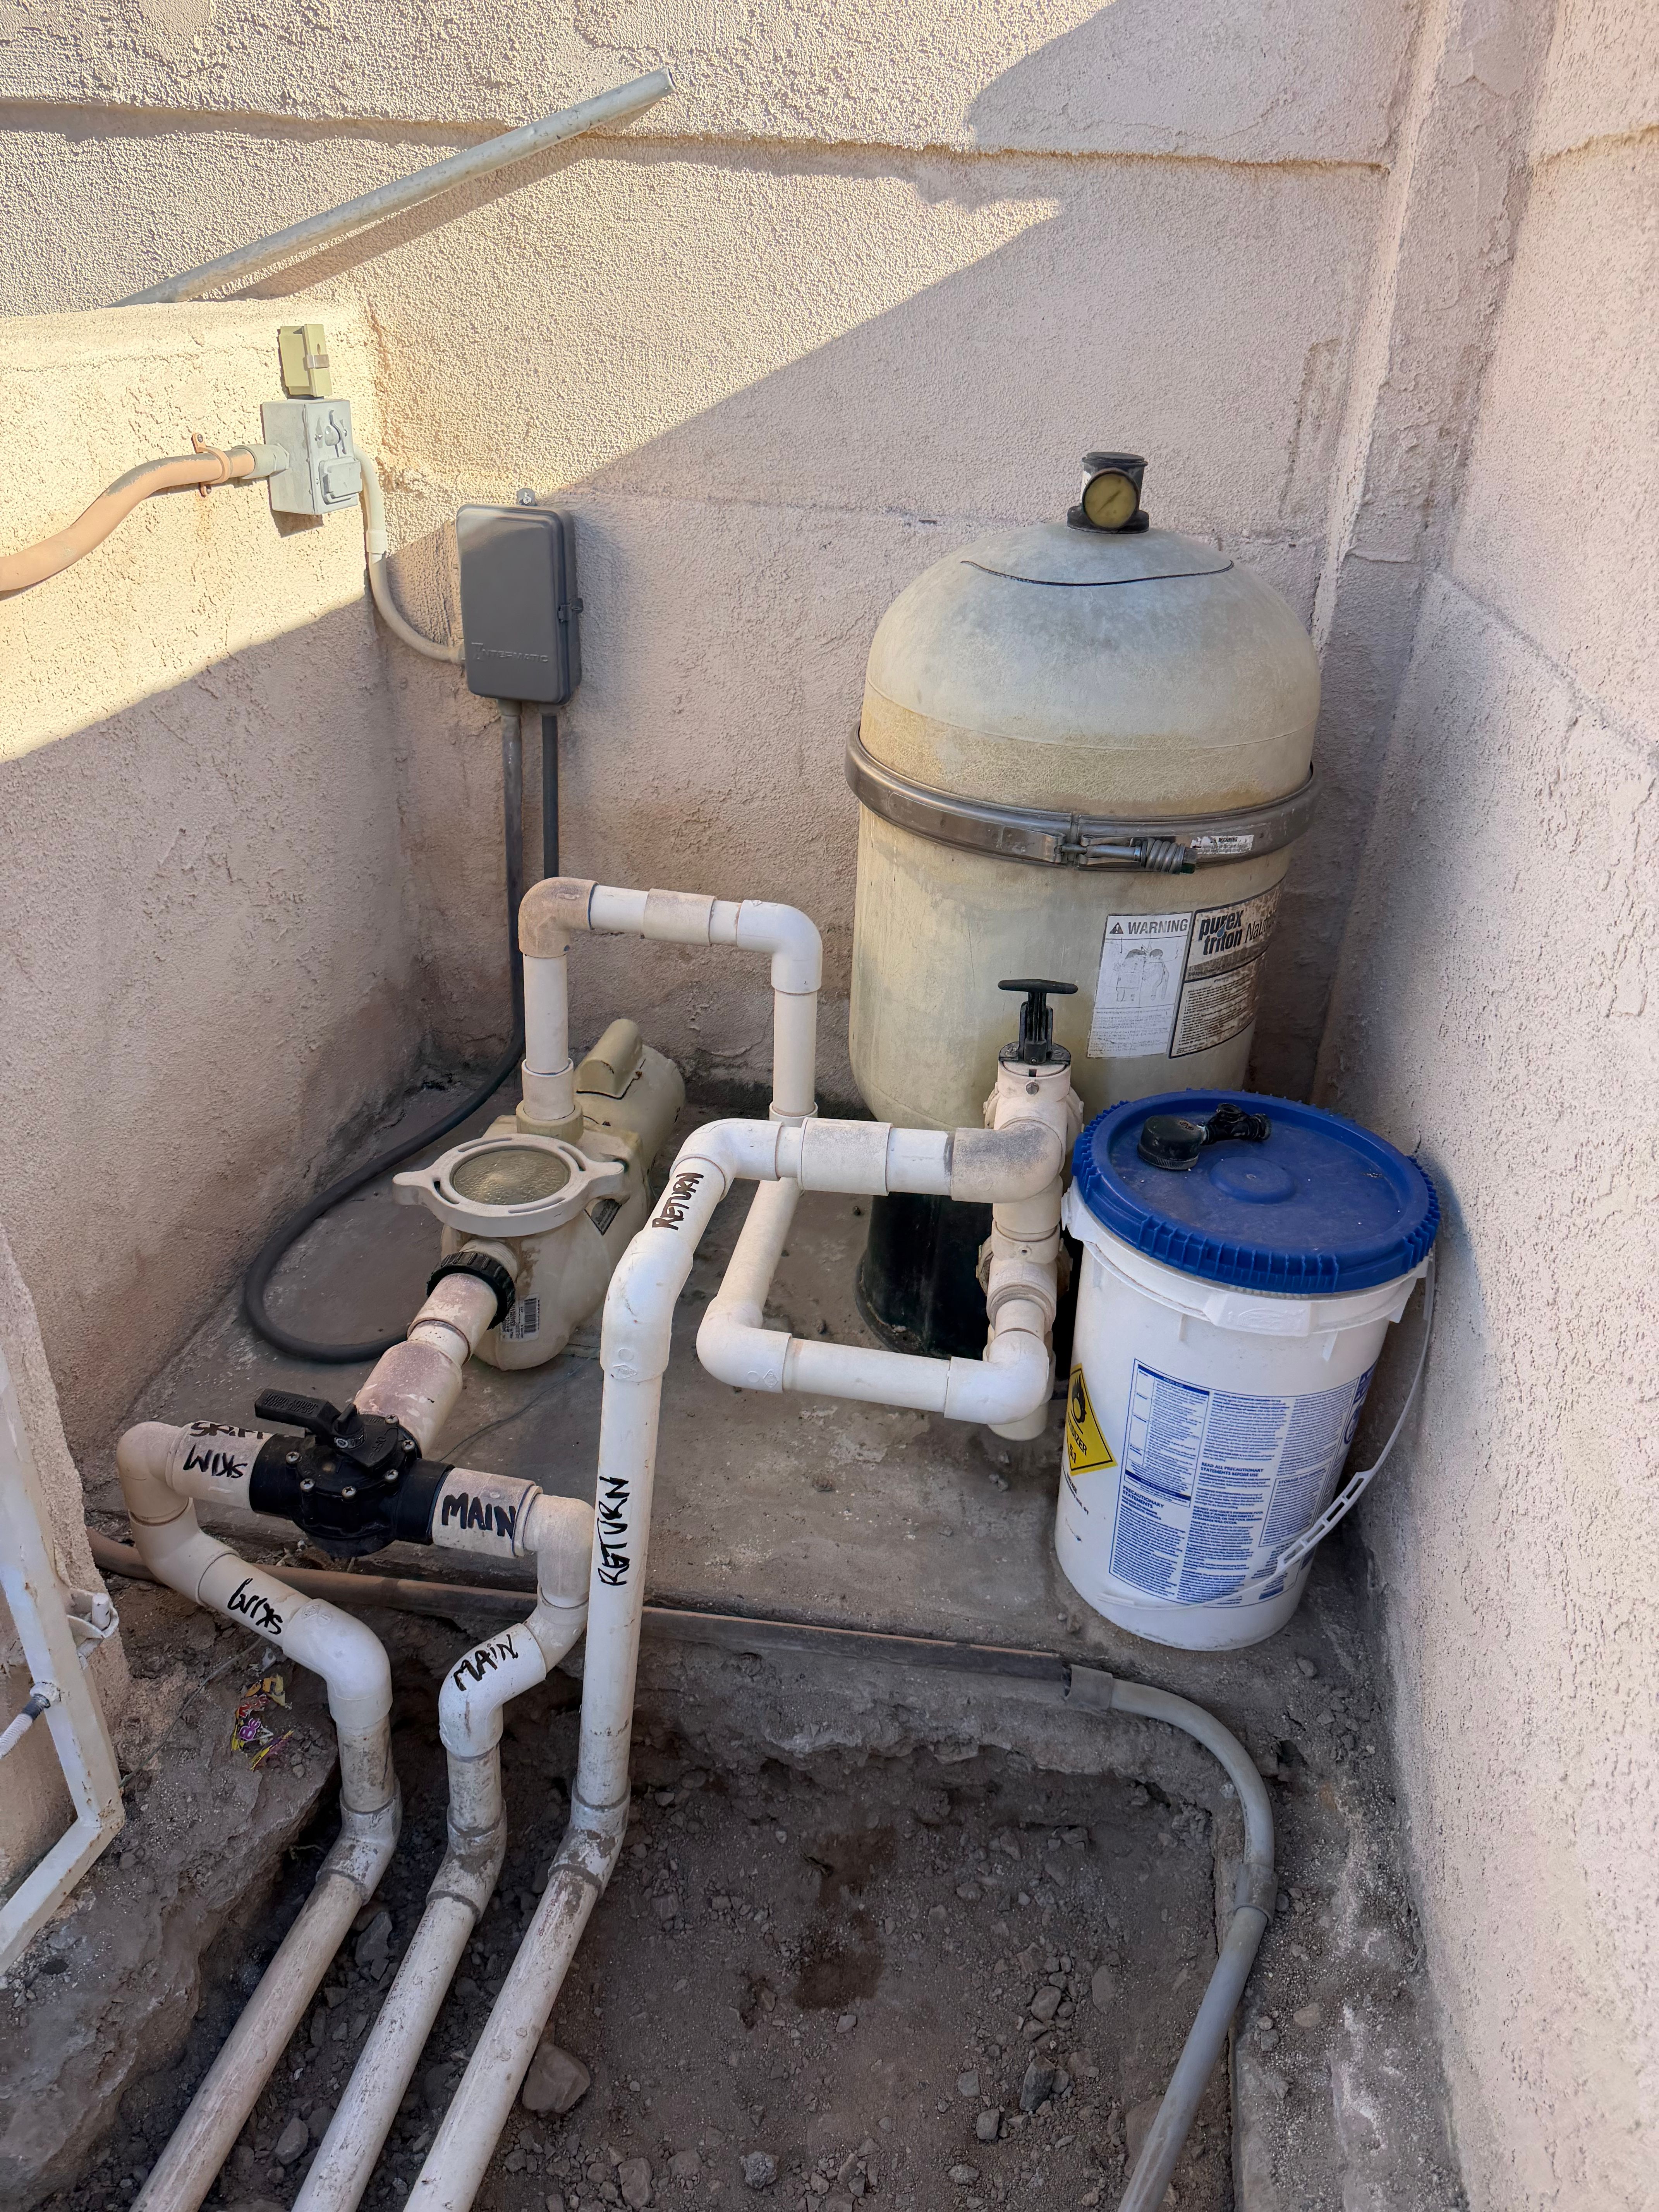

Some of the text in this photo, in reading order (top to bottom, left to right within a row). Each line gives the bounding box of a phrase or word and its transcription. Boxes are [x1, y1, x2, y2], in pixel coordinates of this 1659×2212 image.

[1128, 919, 1188, 934] WARNING
[1198, 910, 1243, 941] purex
[1203, 929, 1243, 955] triton
[652, 1172, 704, 1231] RETURN
[183, 1443, 248, 1479] SKIM
[1123, 1485, 1164, 1508] PRECAUTIONARY
[1123, 1490, 1153, 1509] STATEMENTS
[441, 1492, 516, 1540] MAIN
[598, 1476, 630, 1586] RETURN
[227, 1578, 283, 1635] SKIM
